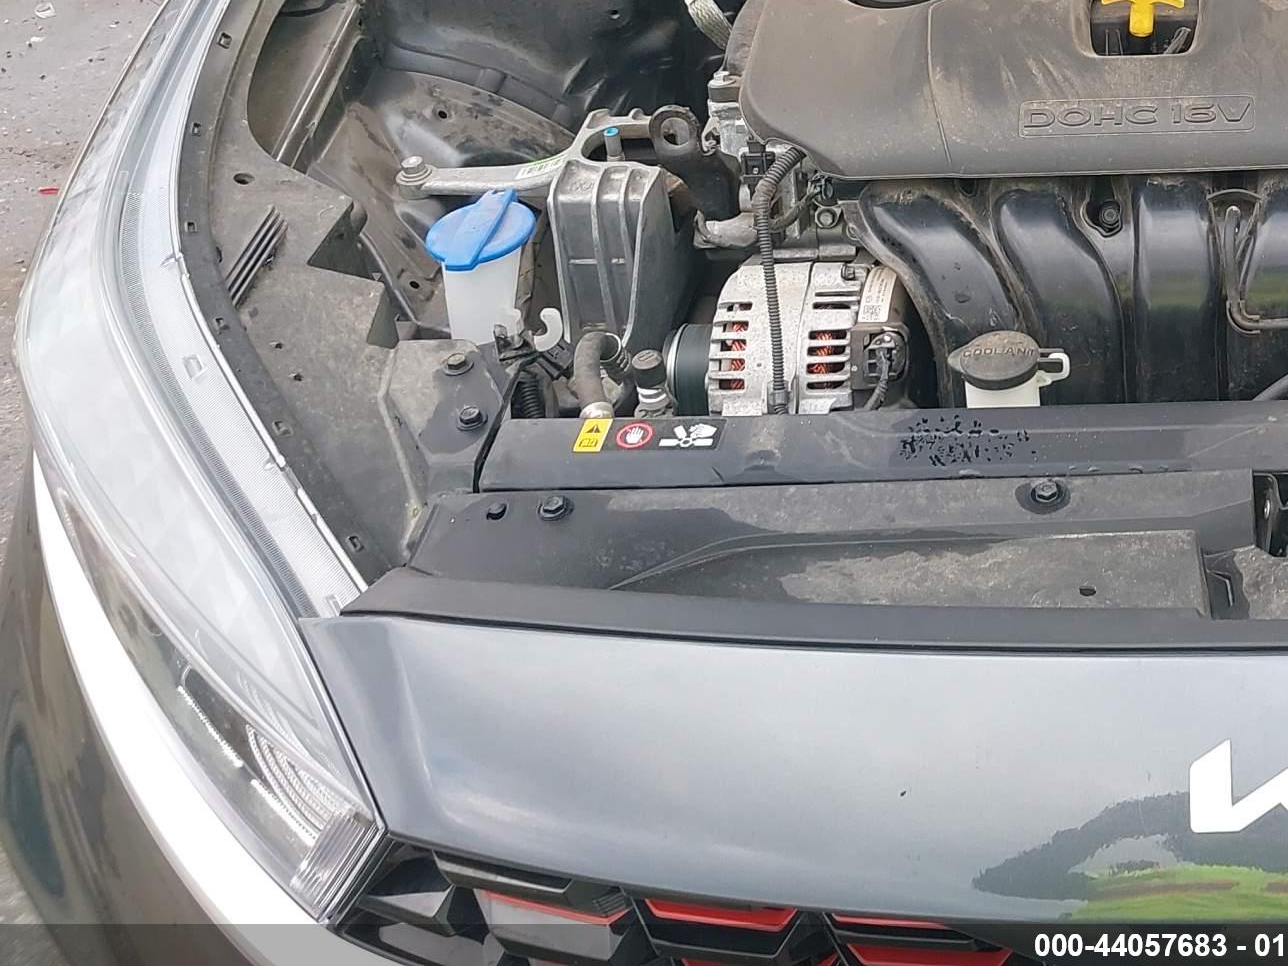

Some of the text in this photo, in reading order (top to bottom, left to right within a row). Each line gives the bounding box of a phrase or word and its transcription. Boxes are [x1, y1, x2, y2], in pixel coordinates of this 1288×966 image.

[1023, 102, 1251, 129] DOHC 16V
[963, 346, 1034, 358] COOLANT
